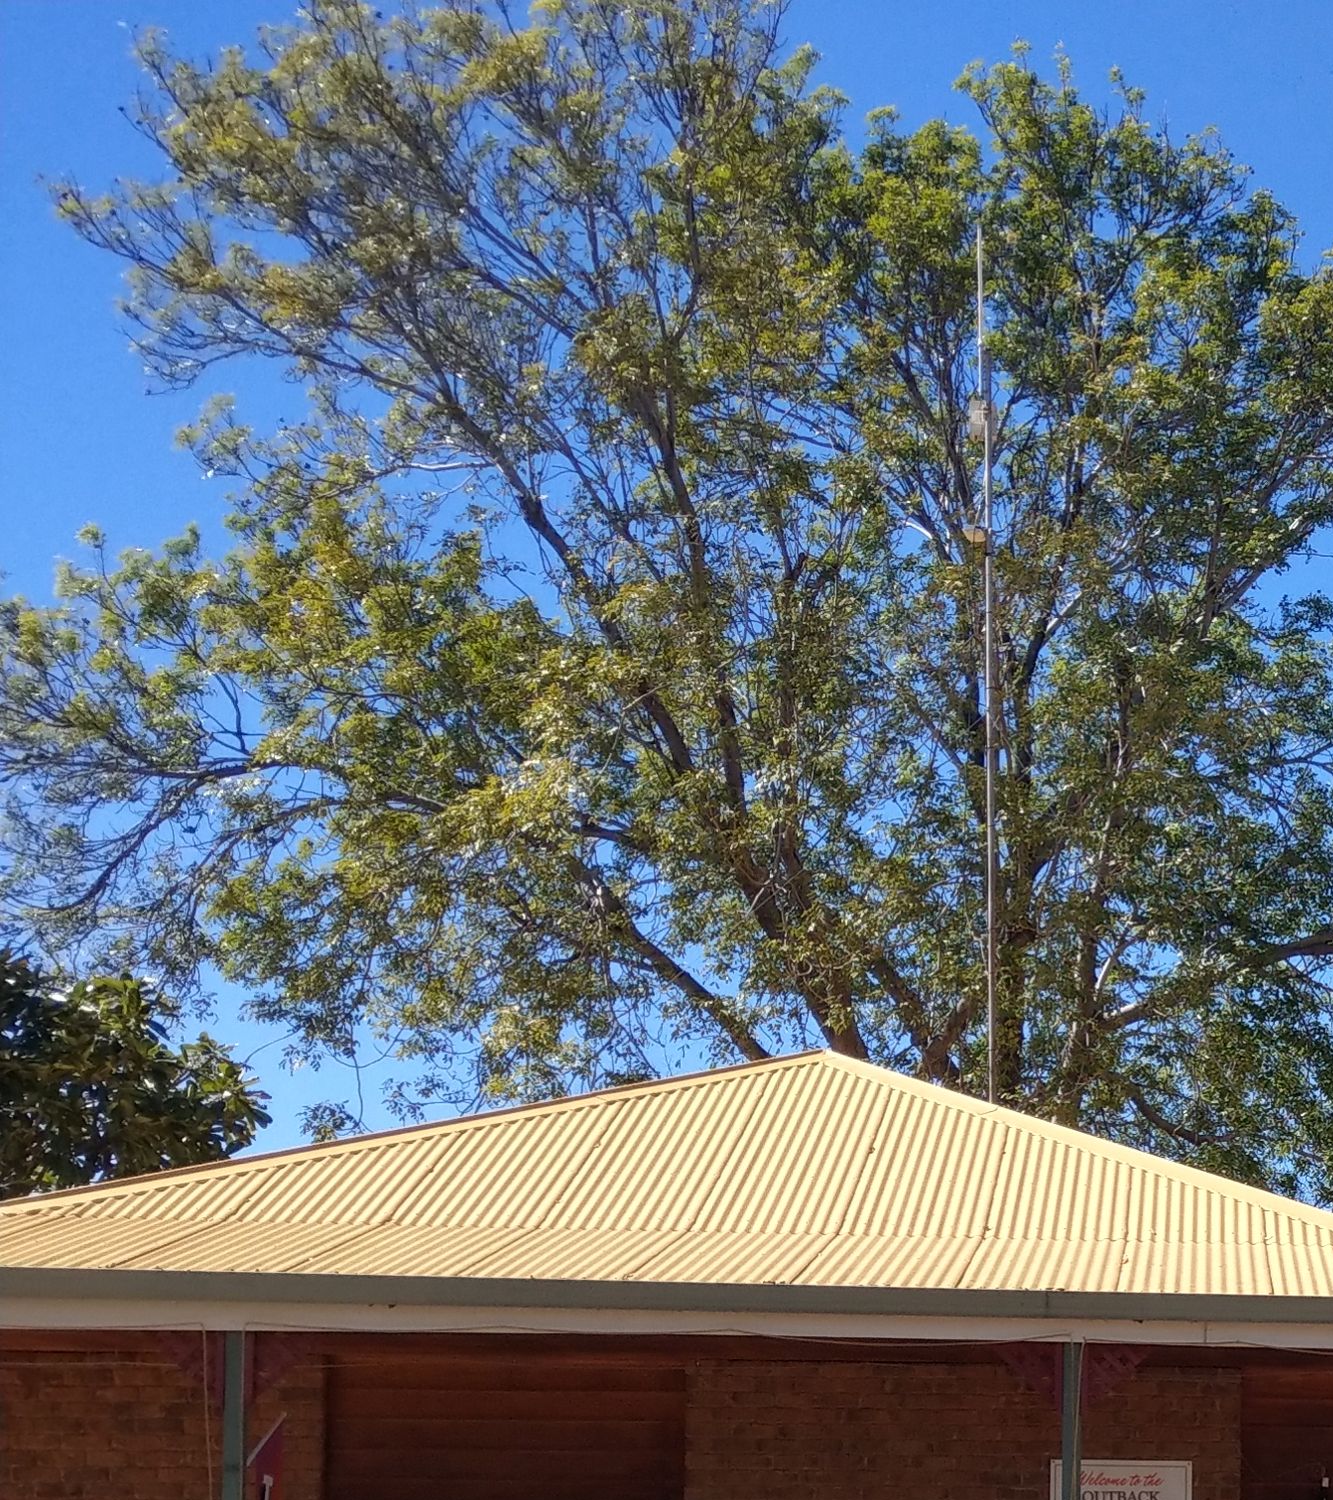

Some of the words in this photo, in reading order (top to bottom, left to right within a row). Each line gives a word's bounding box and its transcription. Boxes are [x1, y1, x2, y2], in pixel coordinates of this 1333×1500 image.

[1080, 1470, 1127, 1486] Welcome
[1128, 1474, 1140, 1486] to
[1143, 1472, 1164, 1486] the
